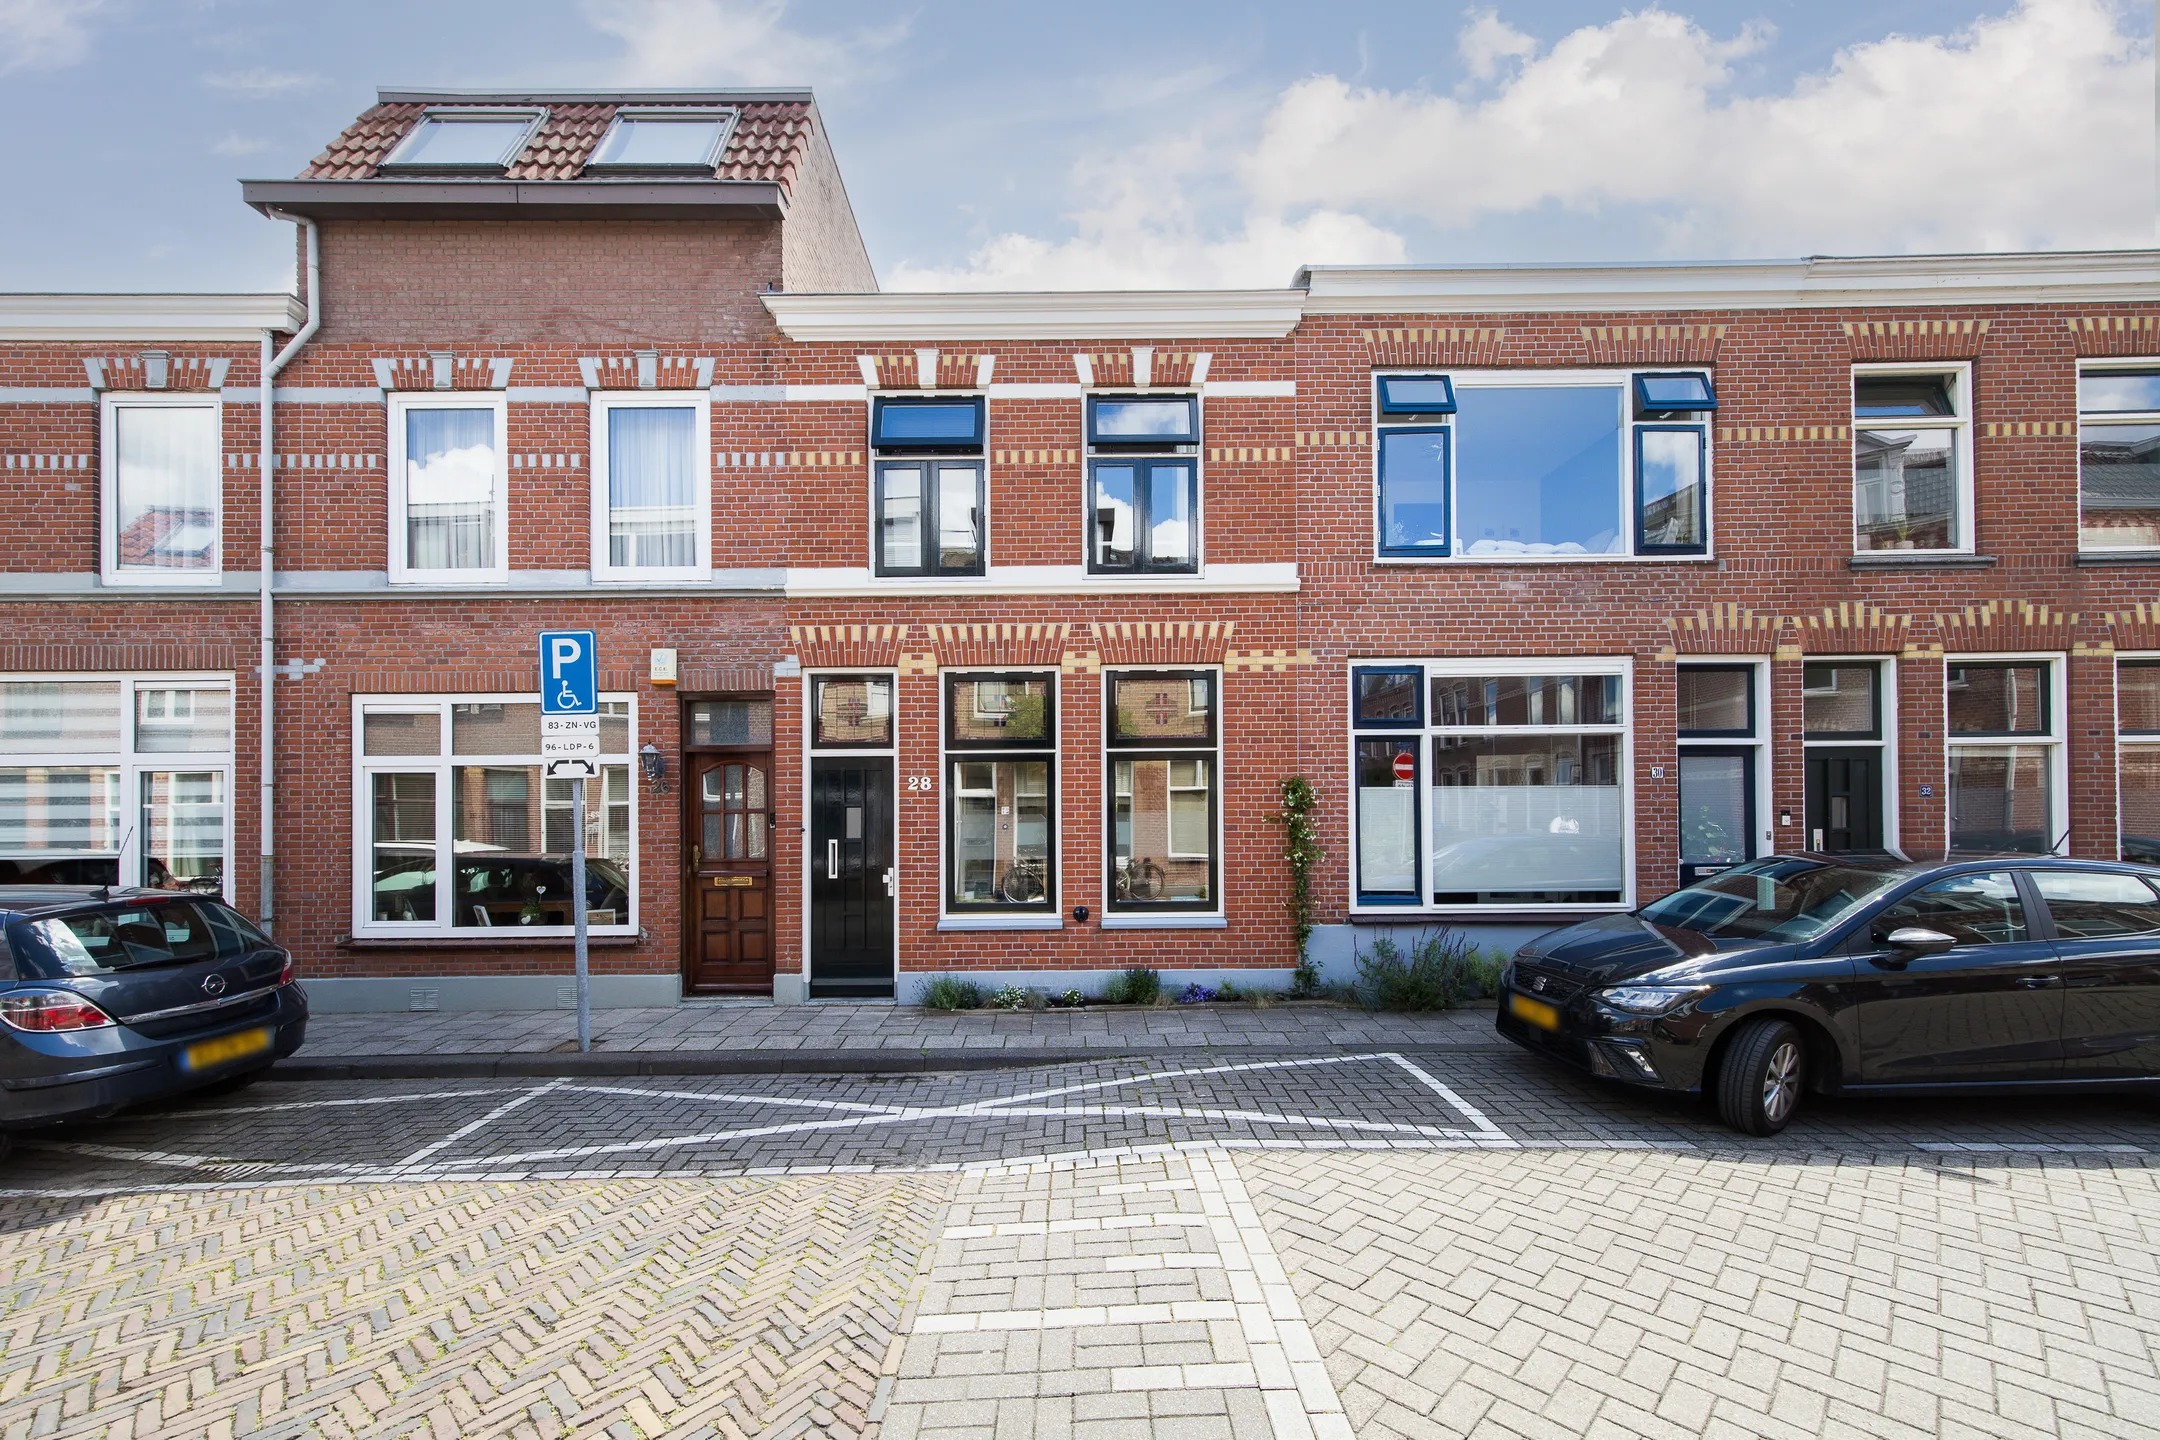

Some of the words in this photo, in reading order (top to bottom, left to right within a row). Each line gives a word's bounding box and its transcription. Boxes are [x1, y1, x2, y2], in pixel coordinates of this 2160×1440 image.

[552, 638, 581, 679] P
[548, 720, 597, 730] 83-ZN-VG
[545, 742, 594, 751] 96-LDP-6
[1652, 767, 1663, 777] 30
[650, 779, 670, 794] 26
[907, 776, 932, 790] 28
[1921, 786, 1931, 795] 32
